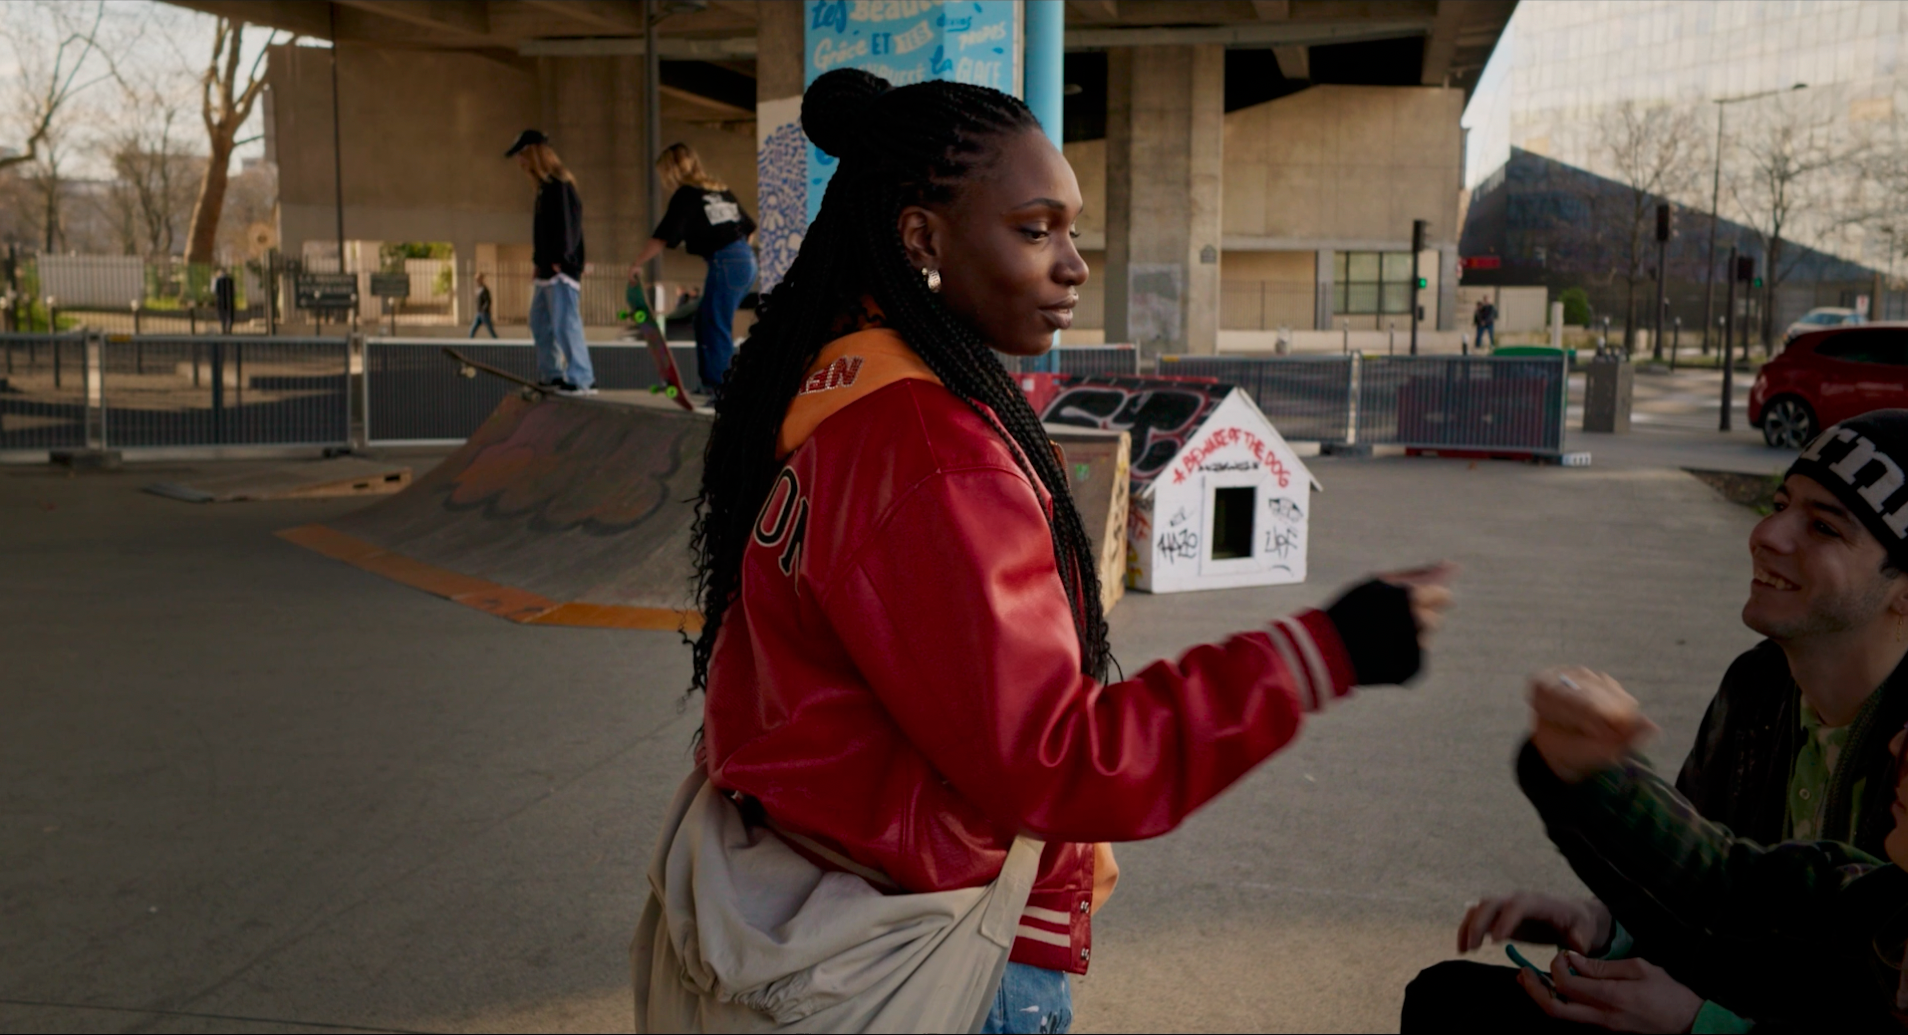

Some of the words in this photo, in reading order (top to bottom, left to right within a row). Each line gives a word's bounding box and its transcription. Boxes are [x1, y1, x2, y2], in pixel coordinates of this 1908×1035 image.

[871, 32, 891, 55] ET
[1182, 428, 1227, 476] BEWARE
[1228, 426, 1242, 446] OF
[1243, 430, 1265, 462] THE
[1264, 450, 1291, 488] DOG
